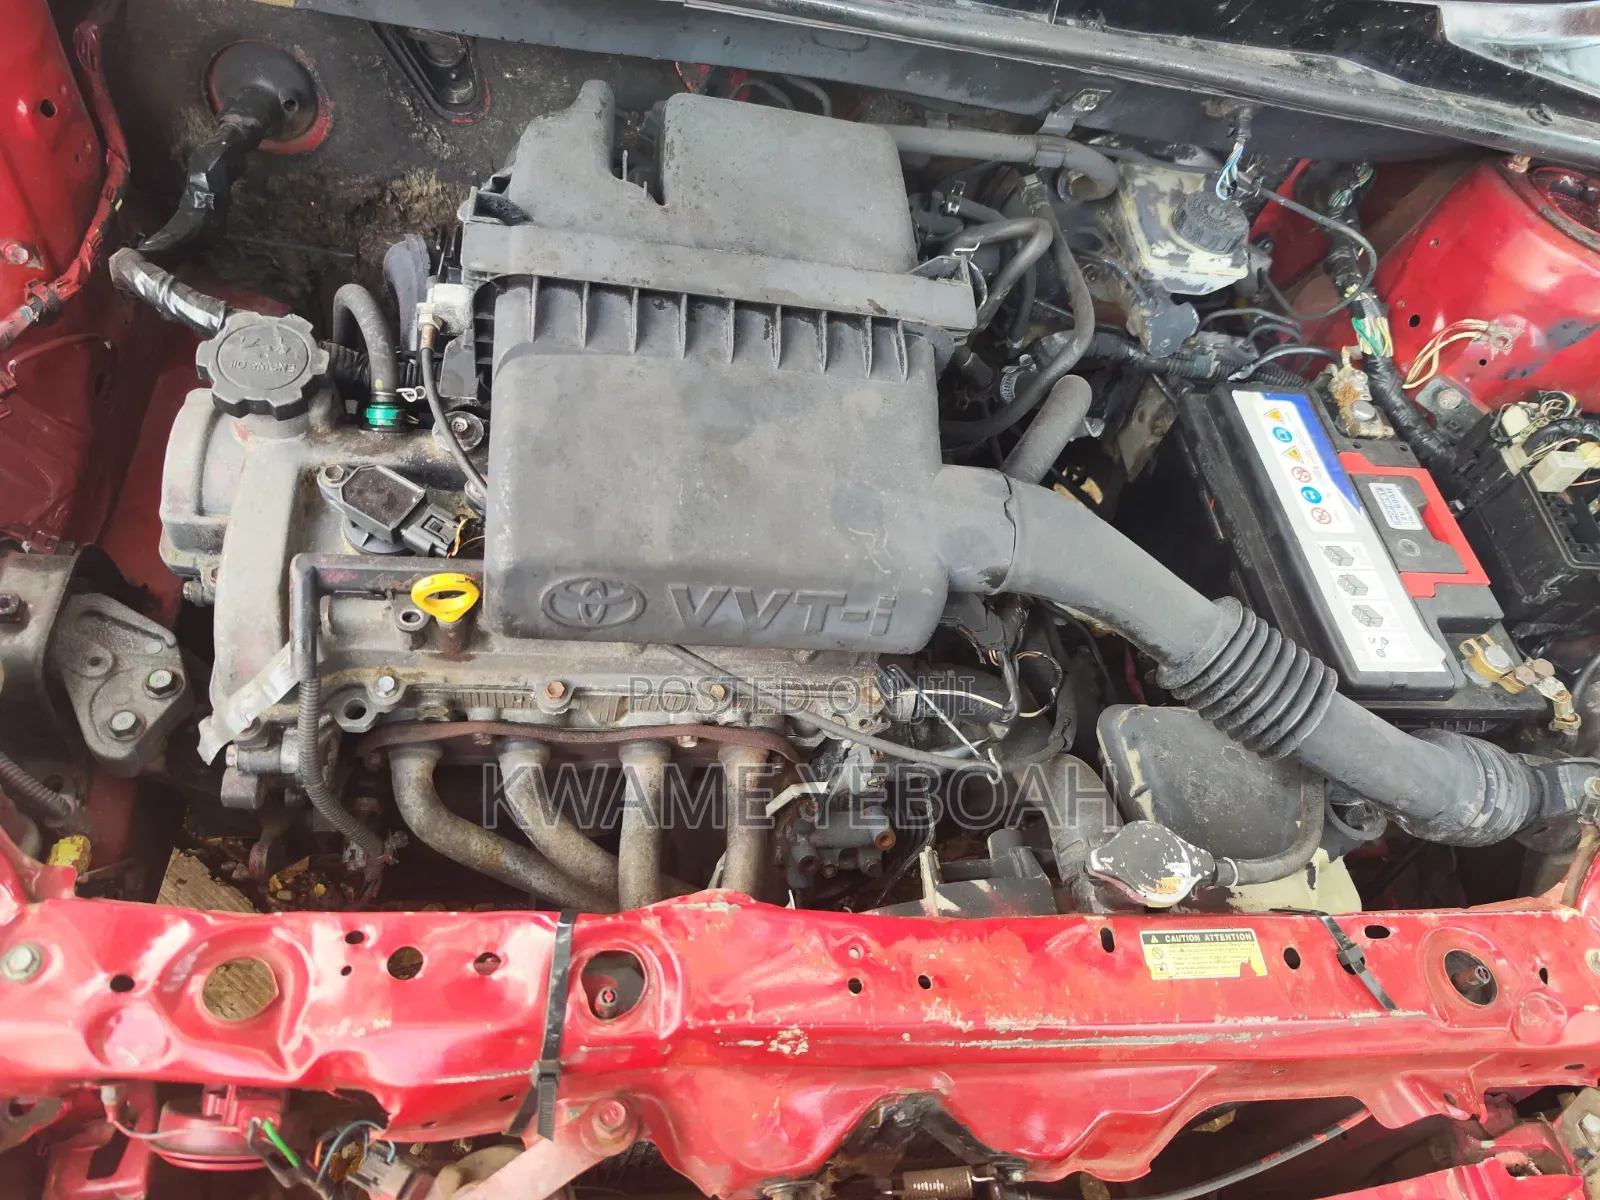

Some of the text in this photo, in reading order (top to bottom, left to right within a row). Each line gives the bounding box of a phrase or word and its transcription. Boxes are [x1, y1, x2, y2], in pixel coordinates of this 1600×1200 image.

[666, 582, 898, 636] VVT-i
[1164, 933, 1252, 943] CAUTION ATTENTION
